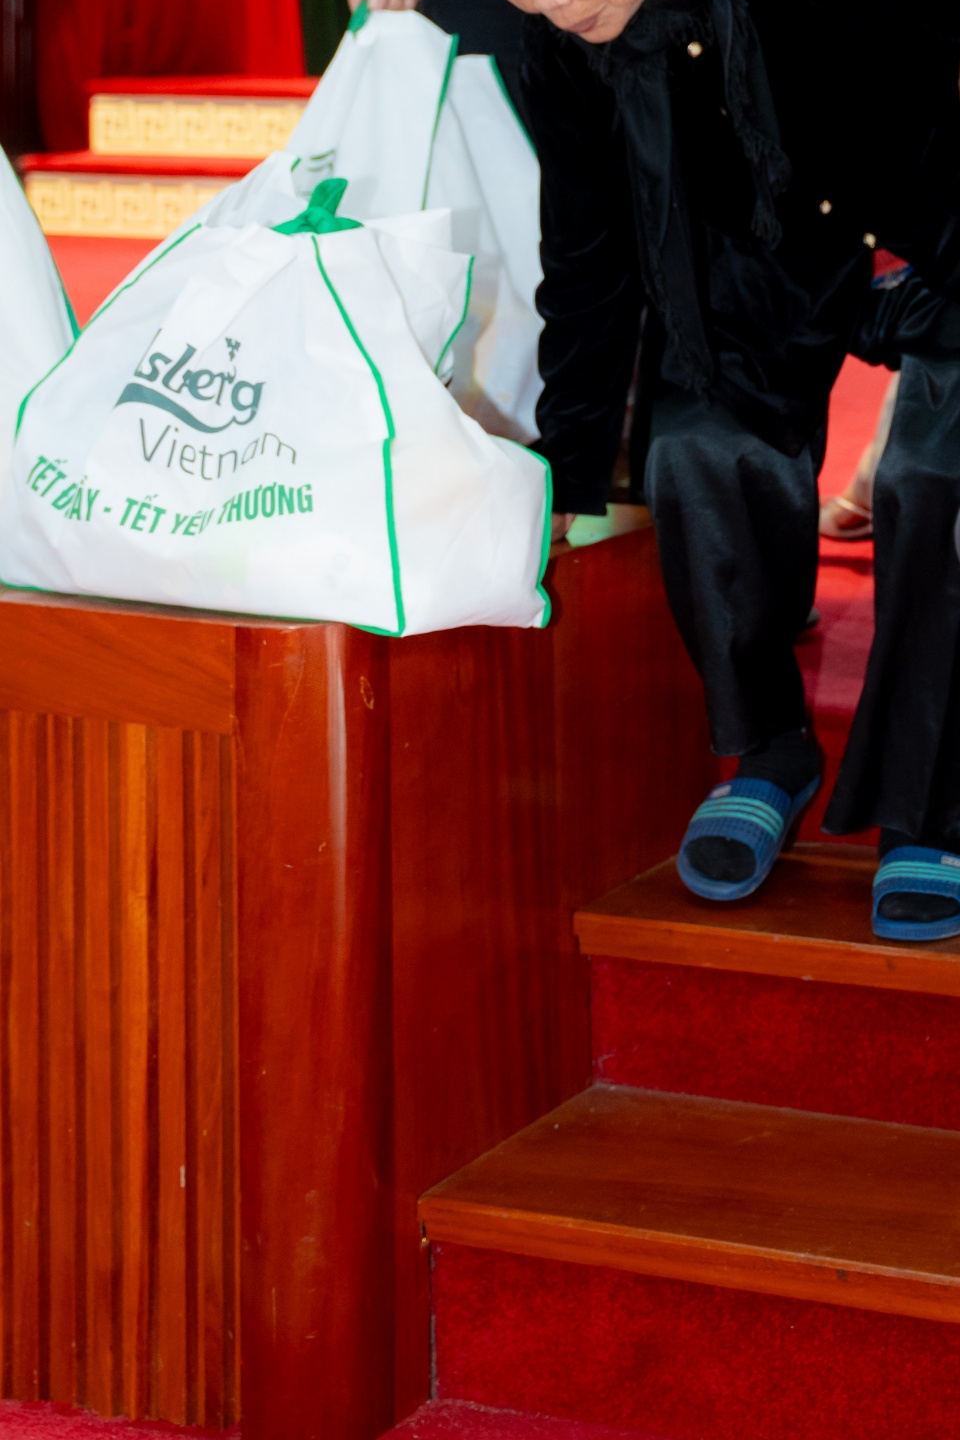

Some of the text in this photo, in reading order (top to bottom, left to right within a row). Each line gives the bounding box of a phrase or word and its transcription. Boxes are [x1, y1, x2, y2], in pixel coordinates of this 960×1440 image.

[139, 417, 297, 481] Vietnam
[26, 455, 68, 498] TẾT
[119, 494, 167, 534] TẾT
[170, 508, 215, 537] YÊU
[217, 481, 314, 526] THƯƠNG
